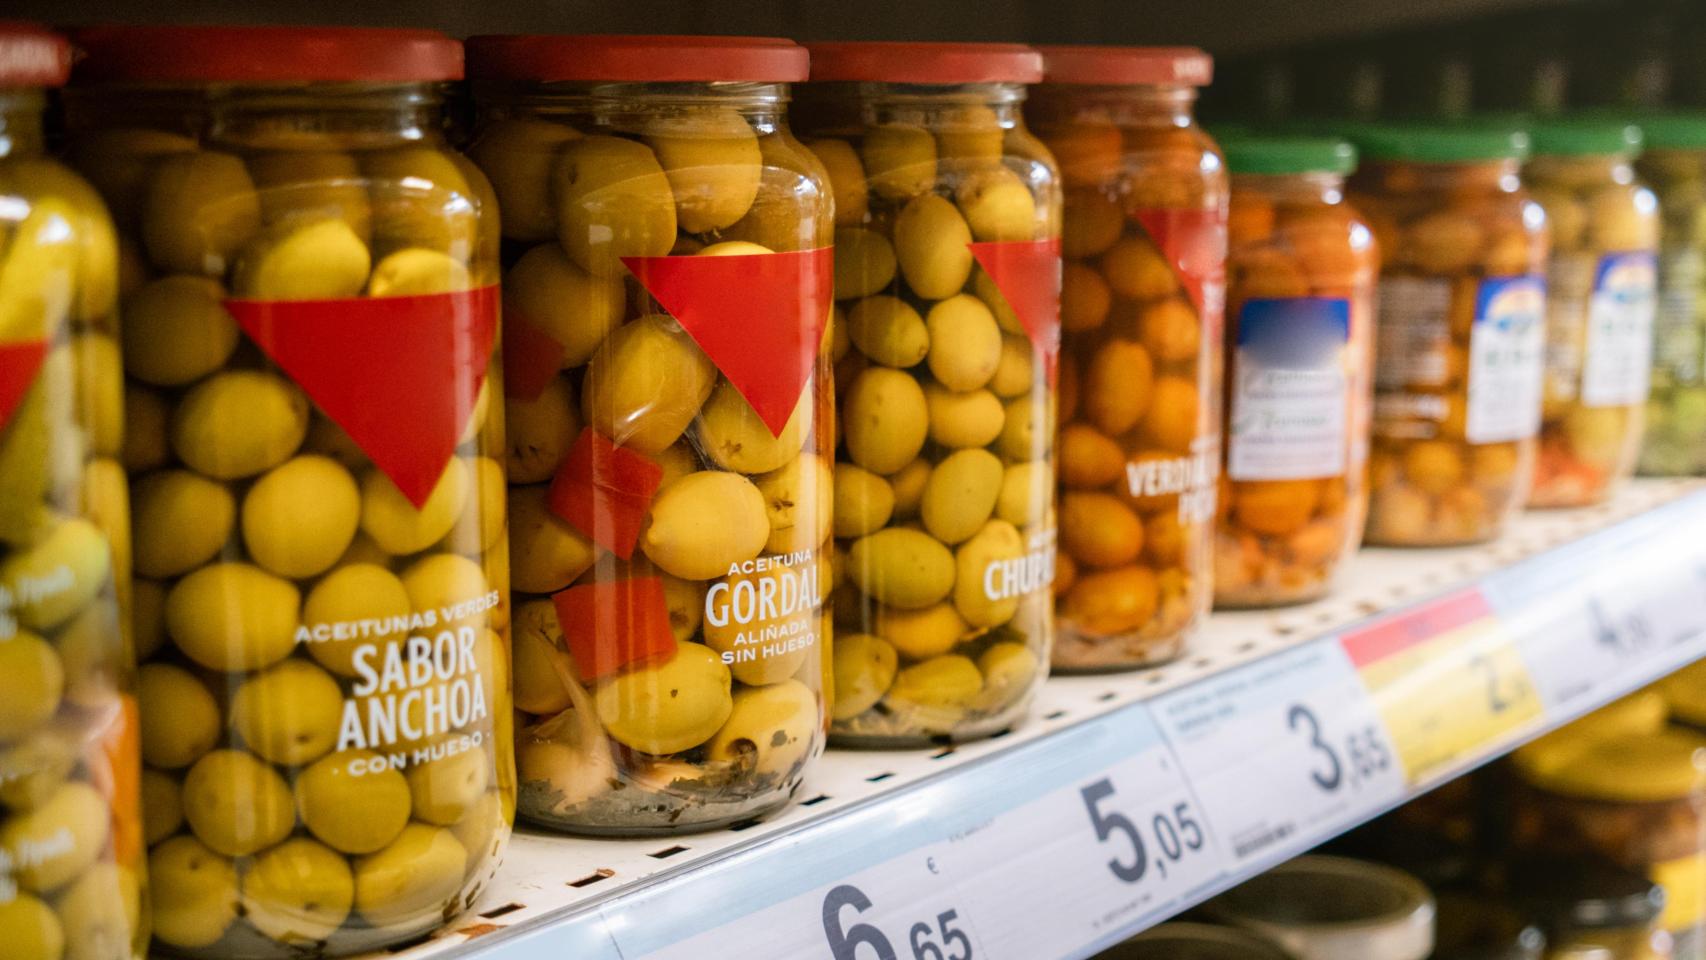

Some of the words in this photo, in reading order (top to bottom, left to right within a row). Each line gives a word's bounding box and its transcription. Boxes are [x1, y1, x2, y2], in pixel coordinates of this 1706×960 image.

[728, 549, 812, 576] ACEITUNA
[294, 610, 437, 642] ACEITUNAS
[441, 590, 499, 622] VERDES
[705, 565, 821, 628] GORDAL
[721, 647, 756, 665] SIN
[762, 632, 815, 658] HUESO
[734, 619, 808, 646] ALIÑADA
[352, 626, 476, 696] SABOR
[336, 673, 488, 752] ANCHOA
[347, 752, 406, 776] CON
[413, 731, 483, 765] HUESO
[1080, 777, 1204, 883] 5,05
[927, 856, 940, 875] €
